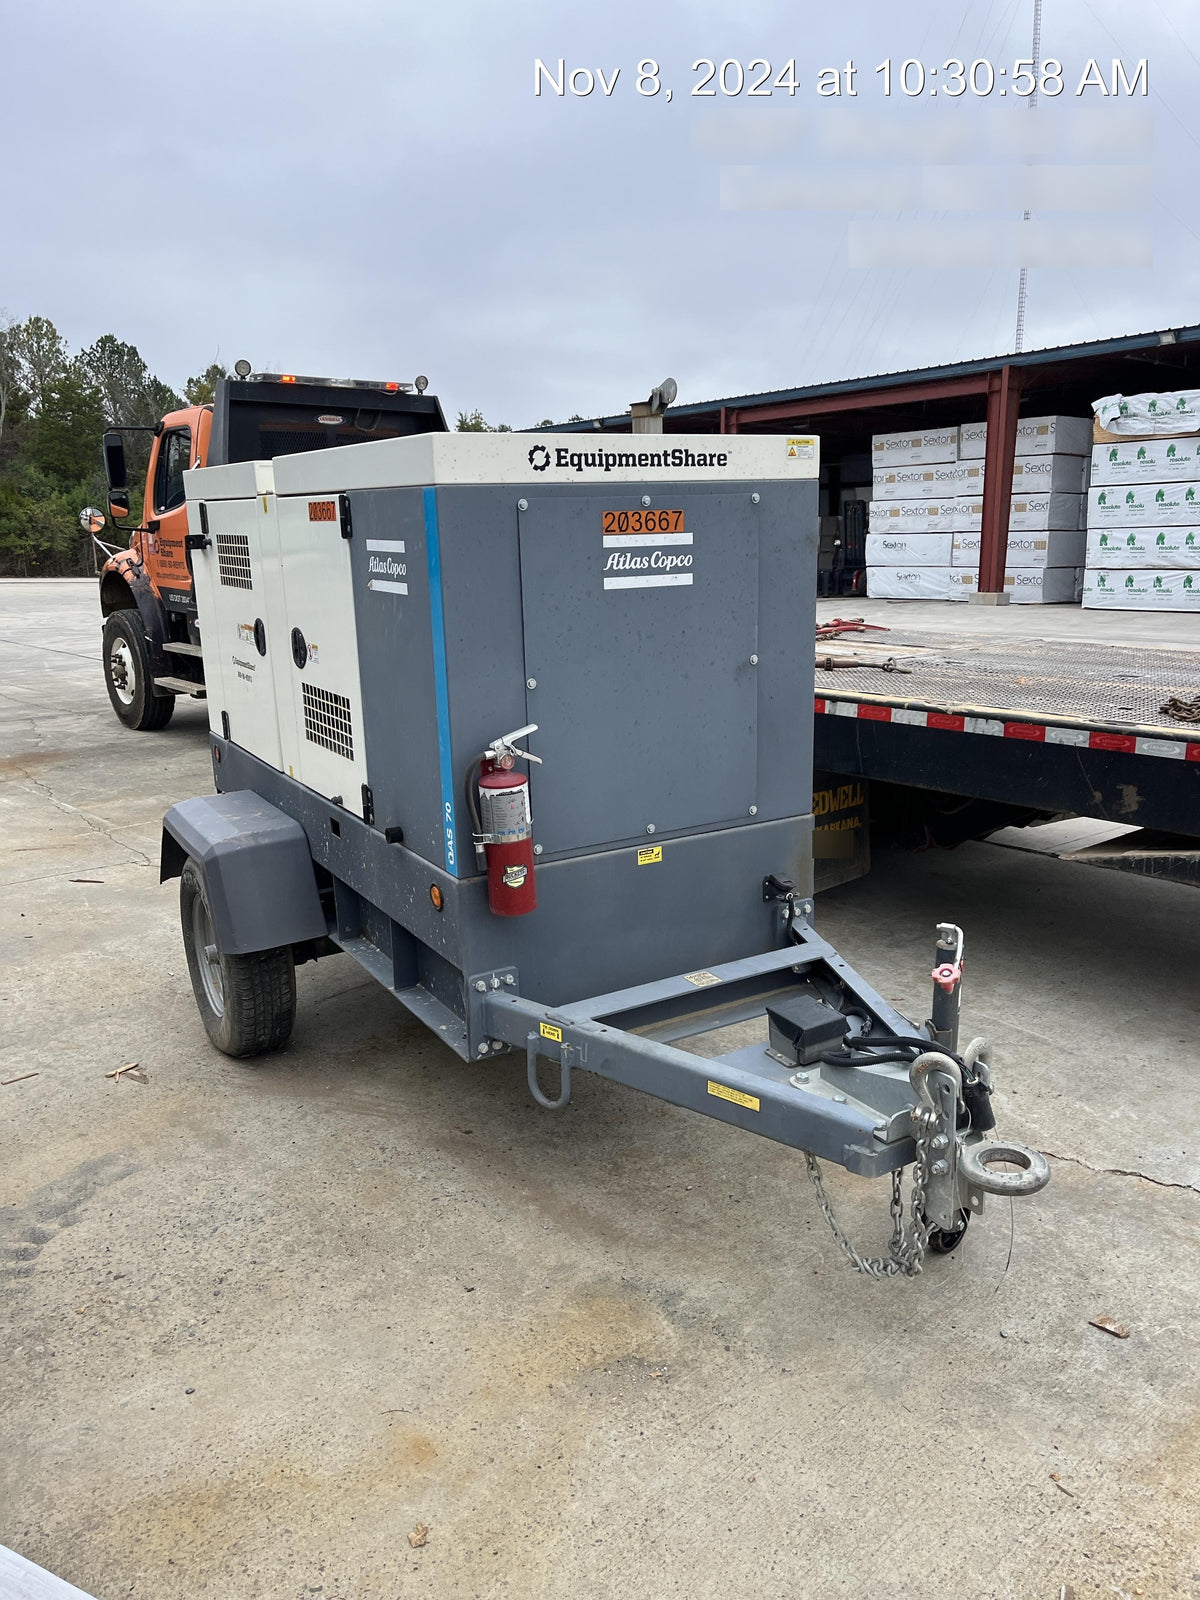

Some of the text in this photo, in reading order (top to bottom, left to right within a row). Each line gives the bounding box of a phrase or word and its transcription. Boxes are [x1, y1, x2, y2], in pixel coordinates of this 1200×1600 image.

[555, 448, 728, 472] EquipmentShare
[309, 501, 335, 520] 203667
[604, 510, 682, 533] 203667
[445, 801, 453, 823] 70
